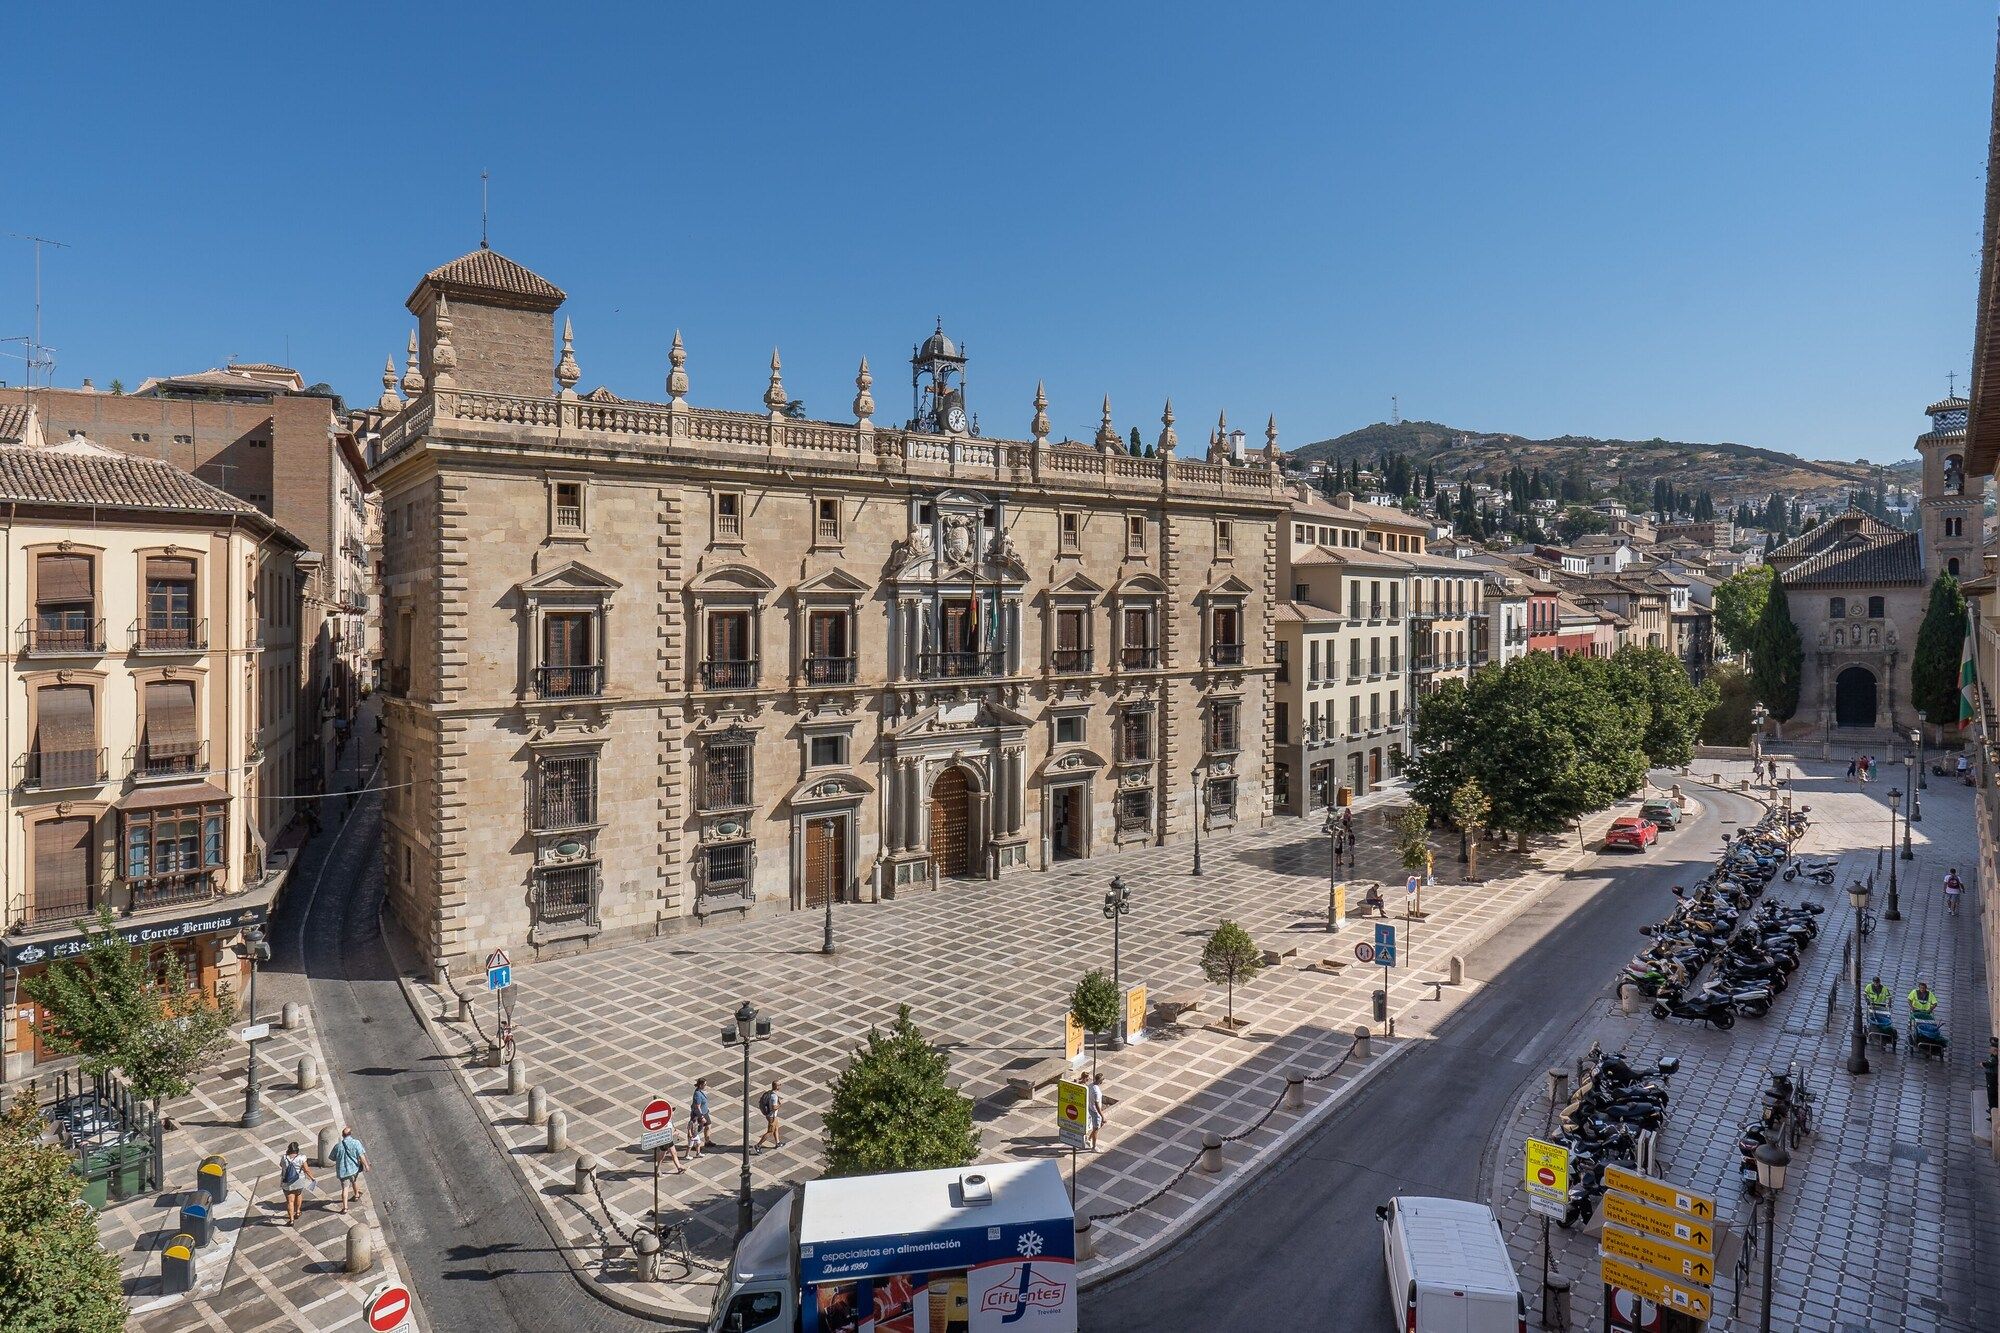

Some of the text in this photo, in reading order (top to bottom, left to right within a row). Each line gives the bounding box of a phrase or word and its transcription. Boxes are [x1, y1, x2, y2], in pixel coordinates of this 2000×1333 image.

[140, 926, 180, 941] Torres
[182, 917, 232, 935] Bermejas
[1616, 1182, 1639, 1193] Ladrón
[1650, 1193, 1667, 1203] Agua
[1607, 1203, 1623, 1213] Casa
[1625, 1209, 1648, 1221] Capitel
[1606, 1211, 1671, 1237] Hotel Casa 1800
[821, 1248, 881, 1262] especialistas
[882, 1247, 895, 1256] en
[897, 1239, 961, 1254] alimentación
[1606, 1236, 1630, 1248] Palacio
[1618, 1248, 1638, 1259] Santa
[1640, 1255, 1654, 1264] Ana
[822, 1262, 869, 1274] Desde 1990
[1605, 1266, 1648, 1287] Casa Morisca
[988, 1288, 1061, 1306] Cifuentes
[1605, 1273, 1628, 1287] Zaguán
[1641, 1288, 1661, 1300] Darro
